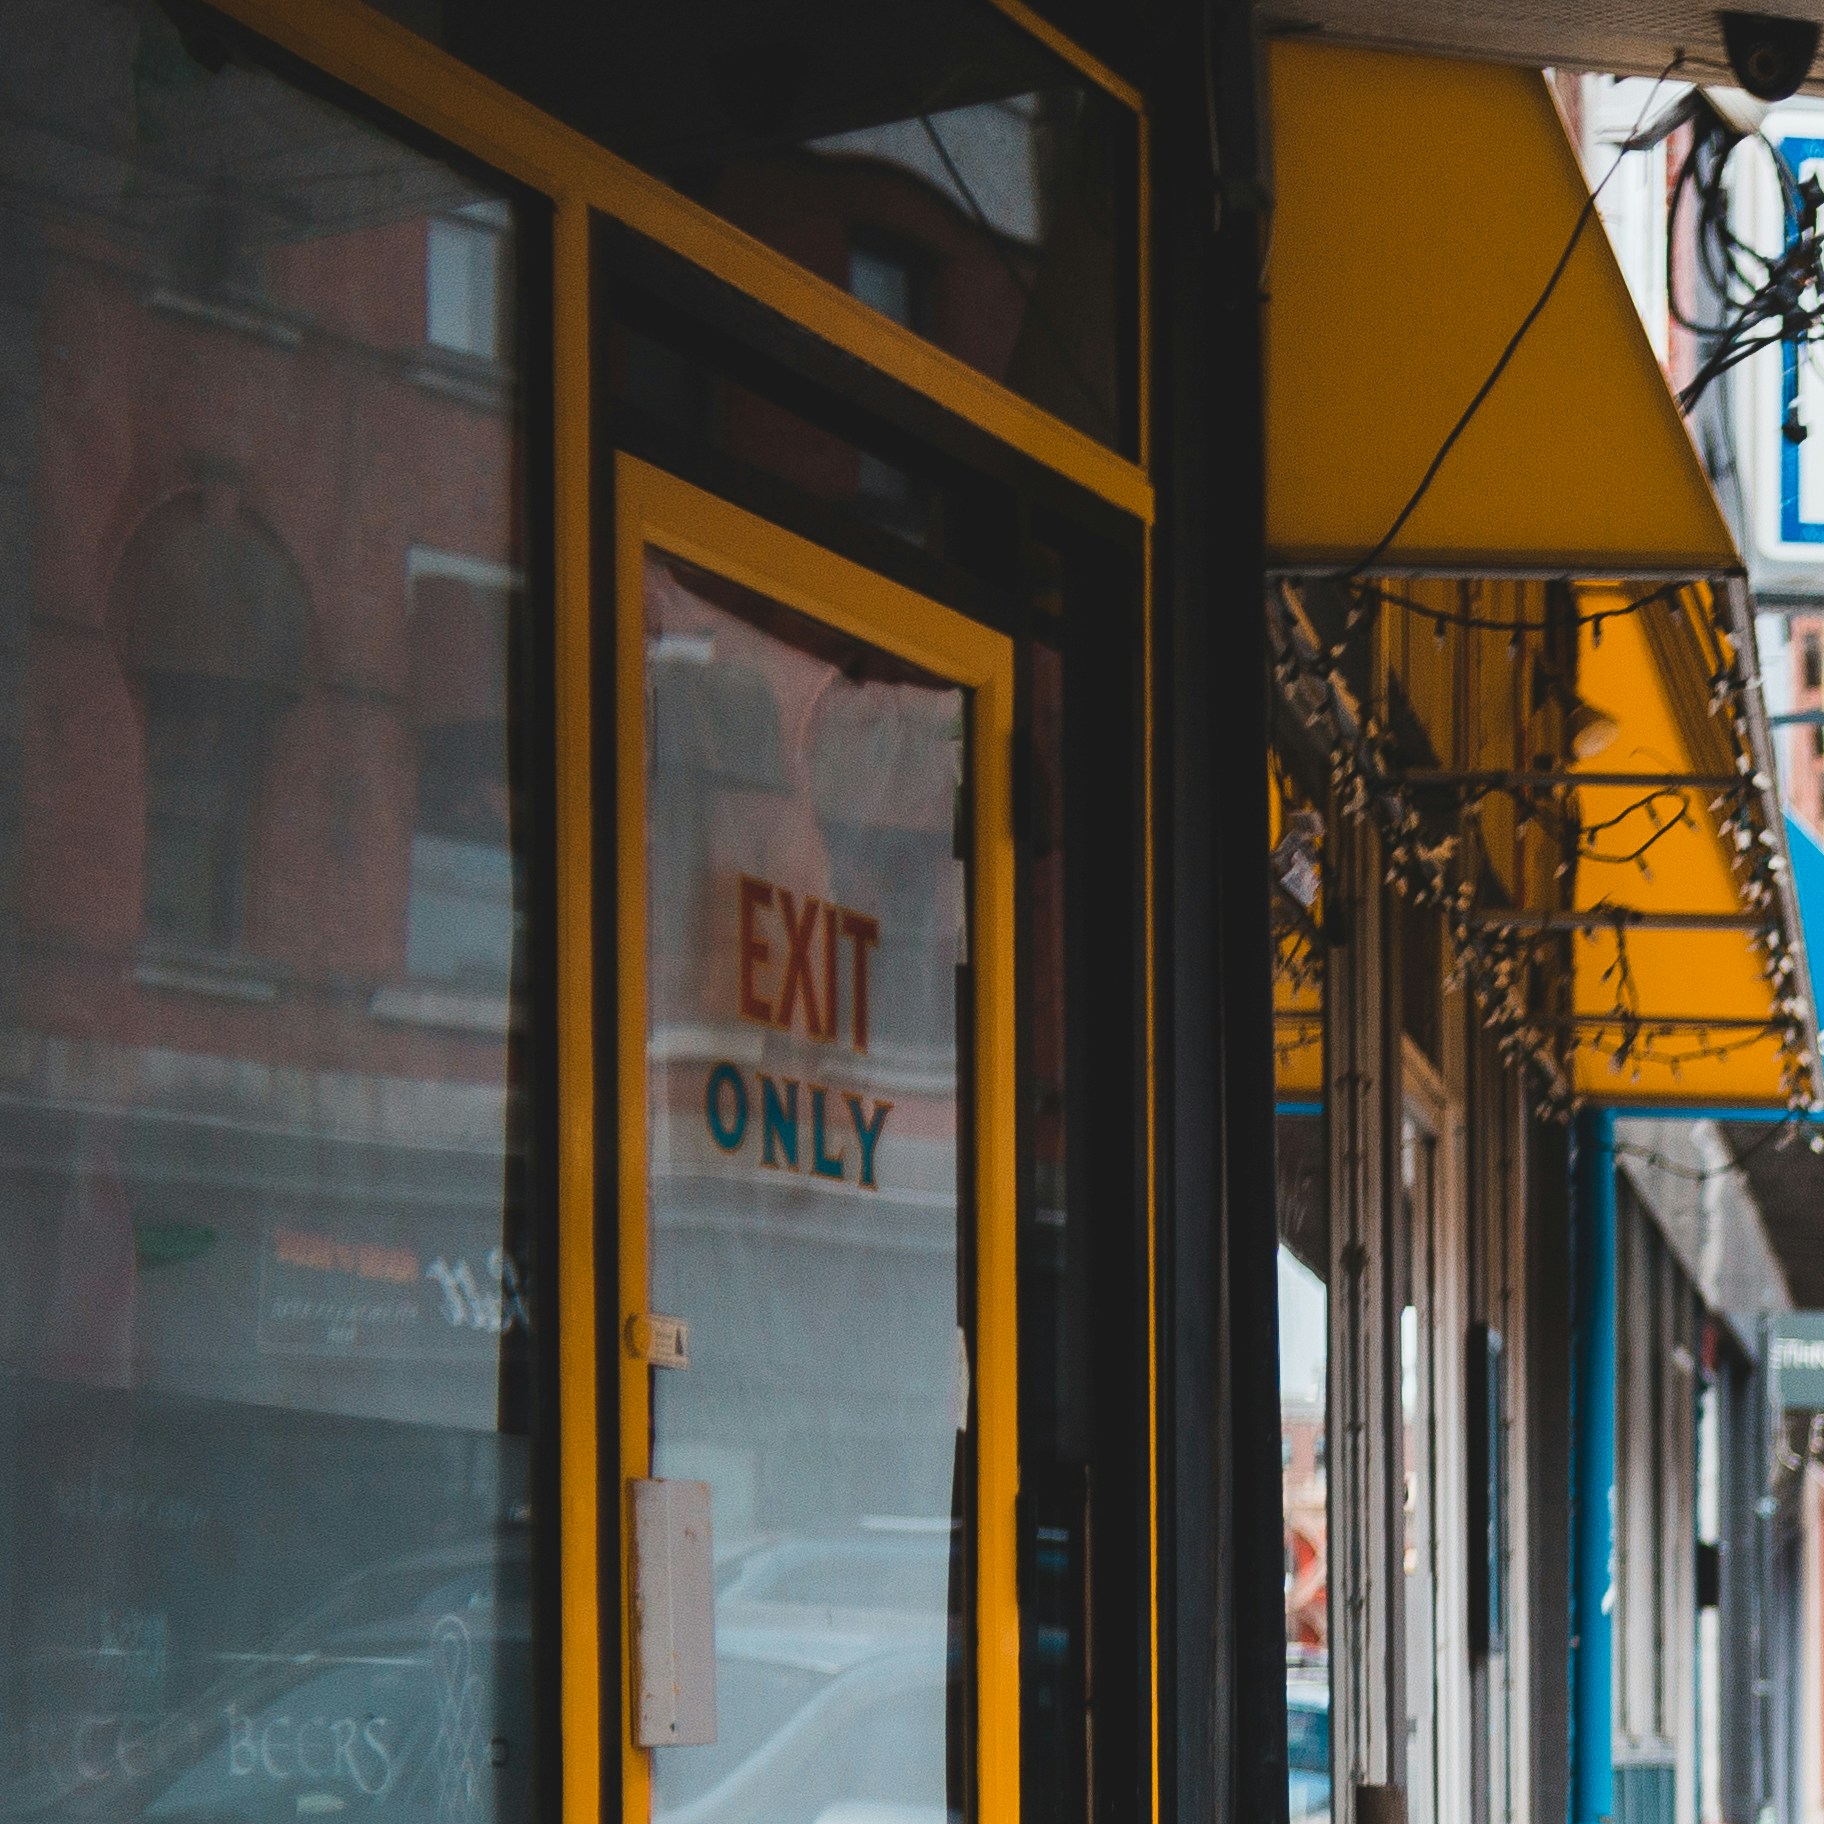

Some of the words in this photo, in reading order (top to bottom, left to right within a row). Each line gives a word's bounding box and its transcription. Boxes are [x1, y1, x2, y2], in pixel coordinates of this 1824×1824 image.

[738, 873, 881, 1056] EXIT
[704, 1058, 895, 1191] ONLY
[223, 1702, 392, 1795] BEERS
